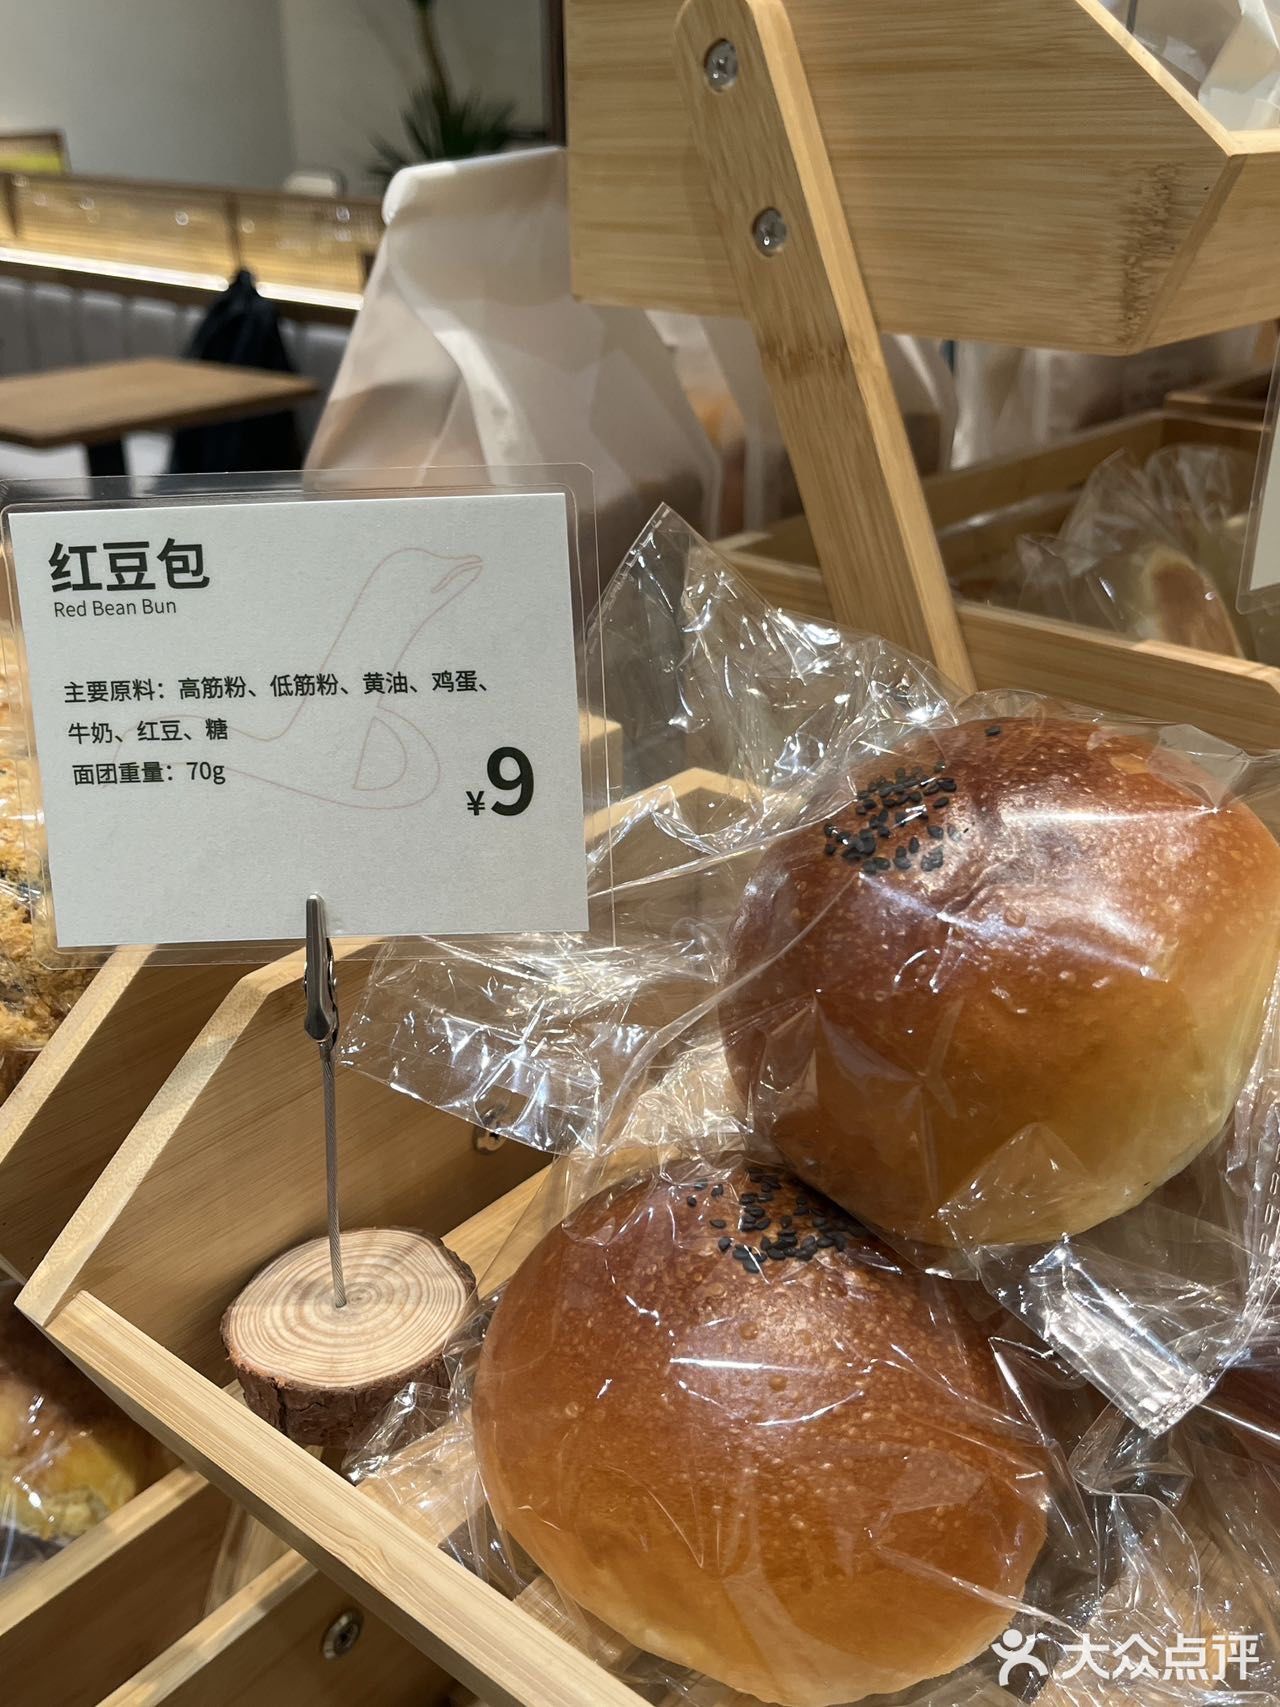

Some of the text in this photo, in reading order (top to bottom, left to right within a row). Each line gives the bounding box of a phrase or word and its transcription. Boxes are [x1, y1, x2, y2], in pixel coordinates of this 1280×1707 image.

[48, 537, 211, 593] 红豆包
[53, 598, 177, 618] Red Bean Bun
[68, 717, 229, 746] 牛奶、红豆、糖
[71, 761, 226, 787] 面团重量：70g
